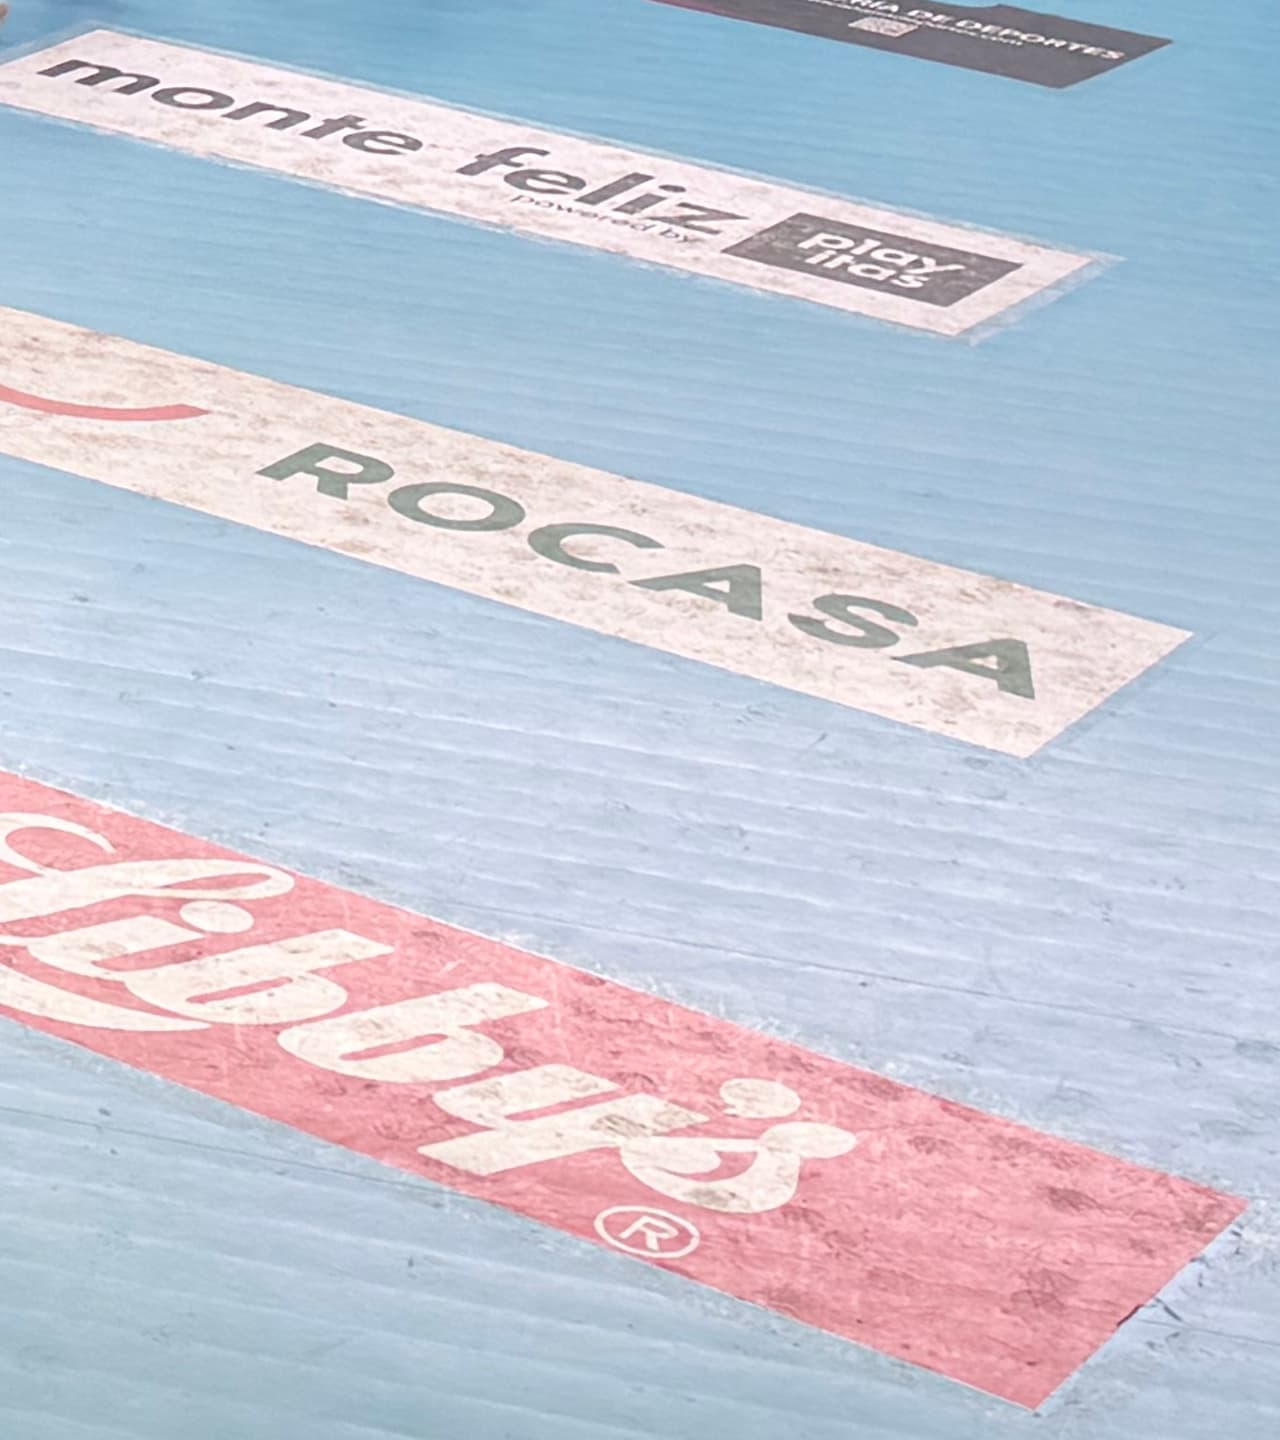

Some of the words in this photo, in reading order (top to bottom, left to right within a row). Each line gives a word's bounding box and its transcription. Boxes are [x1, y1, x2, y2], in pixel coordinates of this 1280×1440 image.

[907, 7, 950, 27] DE
[955, 20, 1126, 60] DEPORTES
[36, 58, 424, 156] monte
[454, 146, 751, 237] feliz
[508, 194, 661, 233] powered
[659, 226, 697, 245] by
[798, 231, 965, 274] play
[803, 250, 931, 290] itas
[254, 441, 1037, 700] ROCASA
